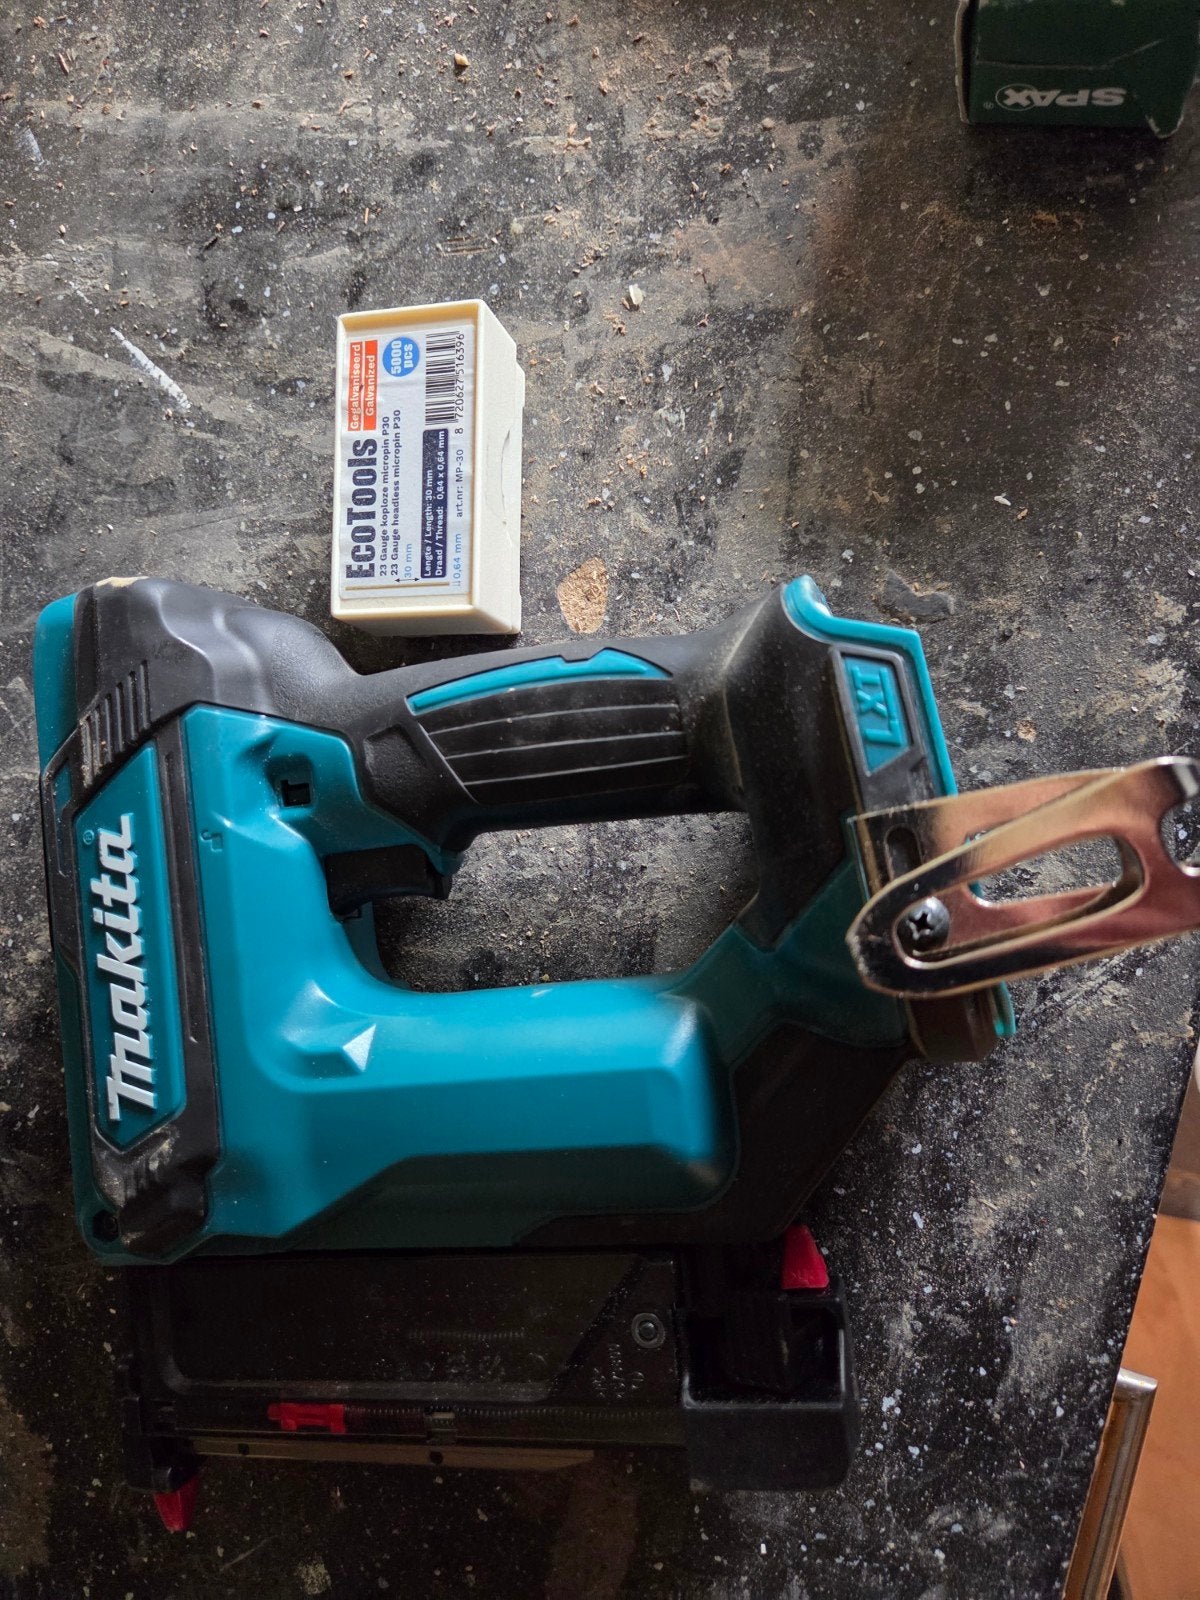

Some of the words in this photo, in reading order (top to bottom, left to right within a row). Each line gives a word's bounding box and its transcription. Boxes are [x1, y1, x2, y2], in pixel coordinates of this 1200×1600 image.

[1002, 85, 1127, 109] SPAX
[391, 341, 402, 374] 5000
[404, 344, 414, 368] pcs
[350, 344, 361, 429] Gegalvaniseerd
[366, 355, 375, 416] Galvanized
[393, 432, 402, 477] micropin
[438, 431, 445, 448] mm
[426, 470, 433, 487] mm
[456, 450, 464, 482] MP-30
[392, 481, 400, 525] headless
[426, 490, 432, 500] 30
[437, 481, 445, 499] 0,64
[455, 486, 463, 517] art.nr:
[346, 439, 378, 578] EcoTools
[381, 487, 389, 526] koploze
[425, 504, 433, 536] Length:
[436, 506, 444, 540] Thread:
[380, 530, 389, 560] Gauge
[391, 529, 400, 560] Gauge
[405, 544, 412, 562] mm
[455, 534, 461, 553] mm
[380, 564, 386, 576] 23
[391, 564, 398, 575] 23
[404, 566, 412, 578] 30
[424, 547, 432, 576] Lengte
[453, 557, 462, 578] 0,64
[851, 667, 901, 747] LXT
